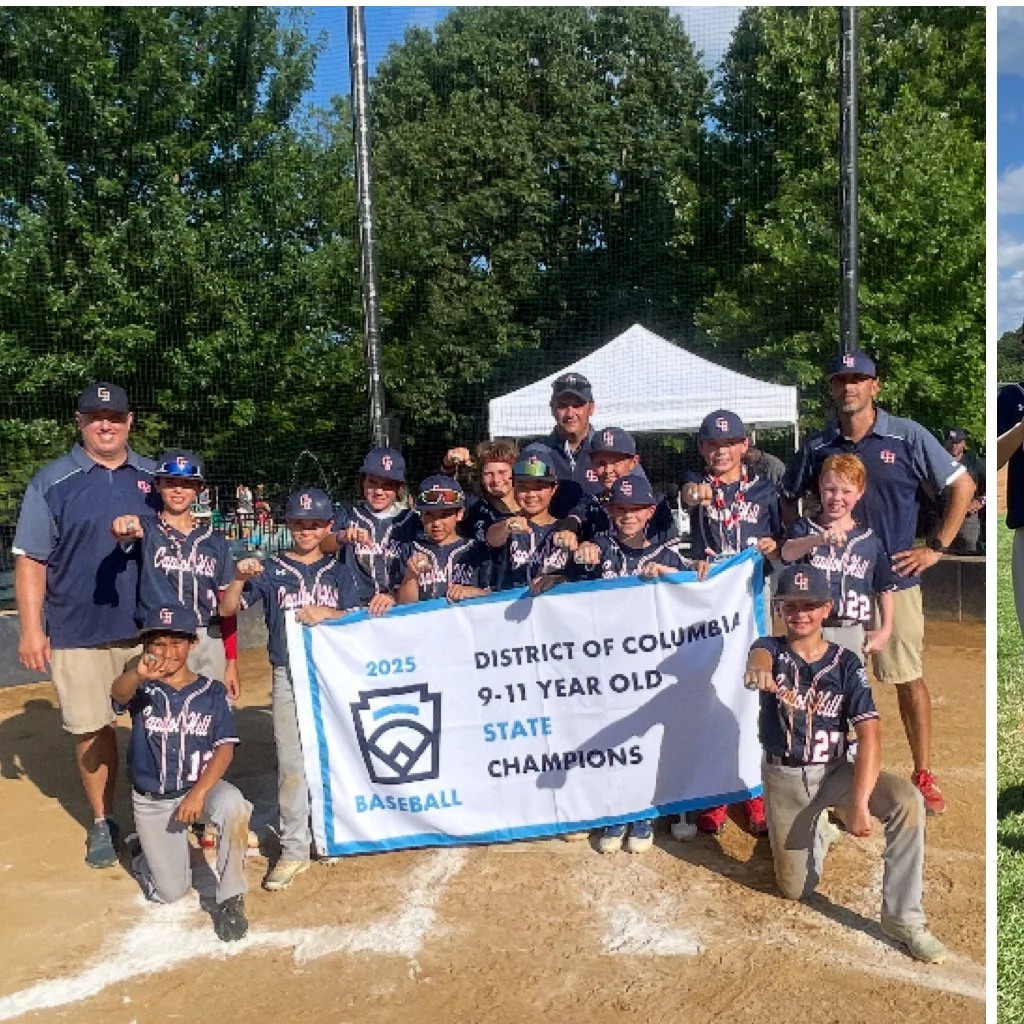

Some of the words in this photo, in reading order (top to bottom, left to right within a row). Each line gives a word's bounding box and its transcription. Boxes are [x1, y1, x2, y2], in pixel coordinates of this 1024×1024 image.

[846, 589, 871, 621] 22
[474, 641, 574, 669] DISTRICT
[583, 638, 614, 658] OF
[622, 612, 740, 654] COLUMBIA
[366, 656, 416, 677] 2025
[477, 682, 527, 707] 9-11
[536, 676, 602, 699] YEAR
[609, 669, 663, 693] OLD
[483, 716, 553, 742] STATE
[487, 745, 643, 778] CHAMPIONS
[812, 730, 844, 763] 27
[354, 789, 463, 813] BASEBALL
